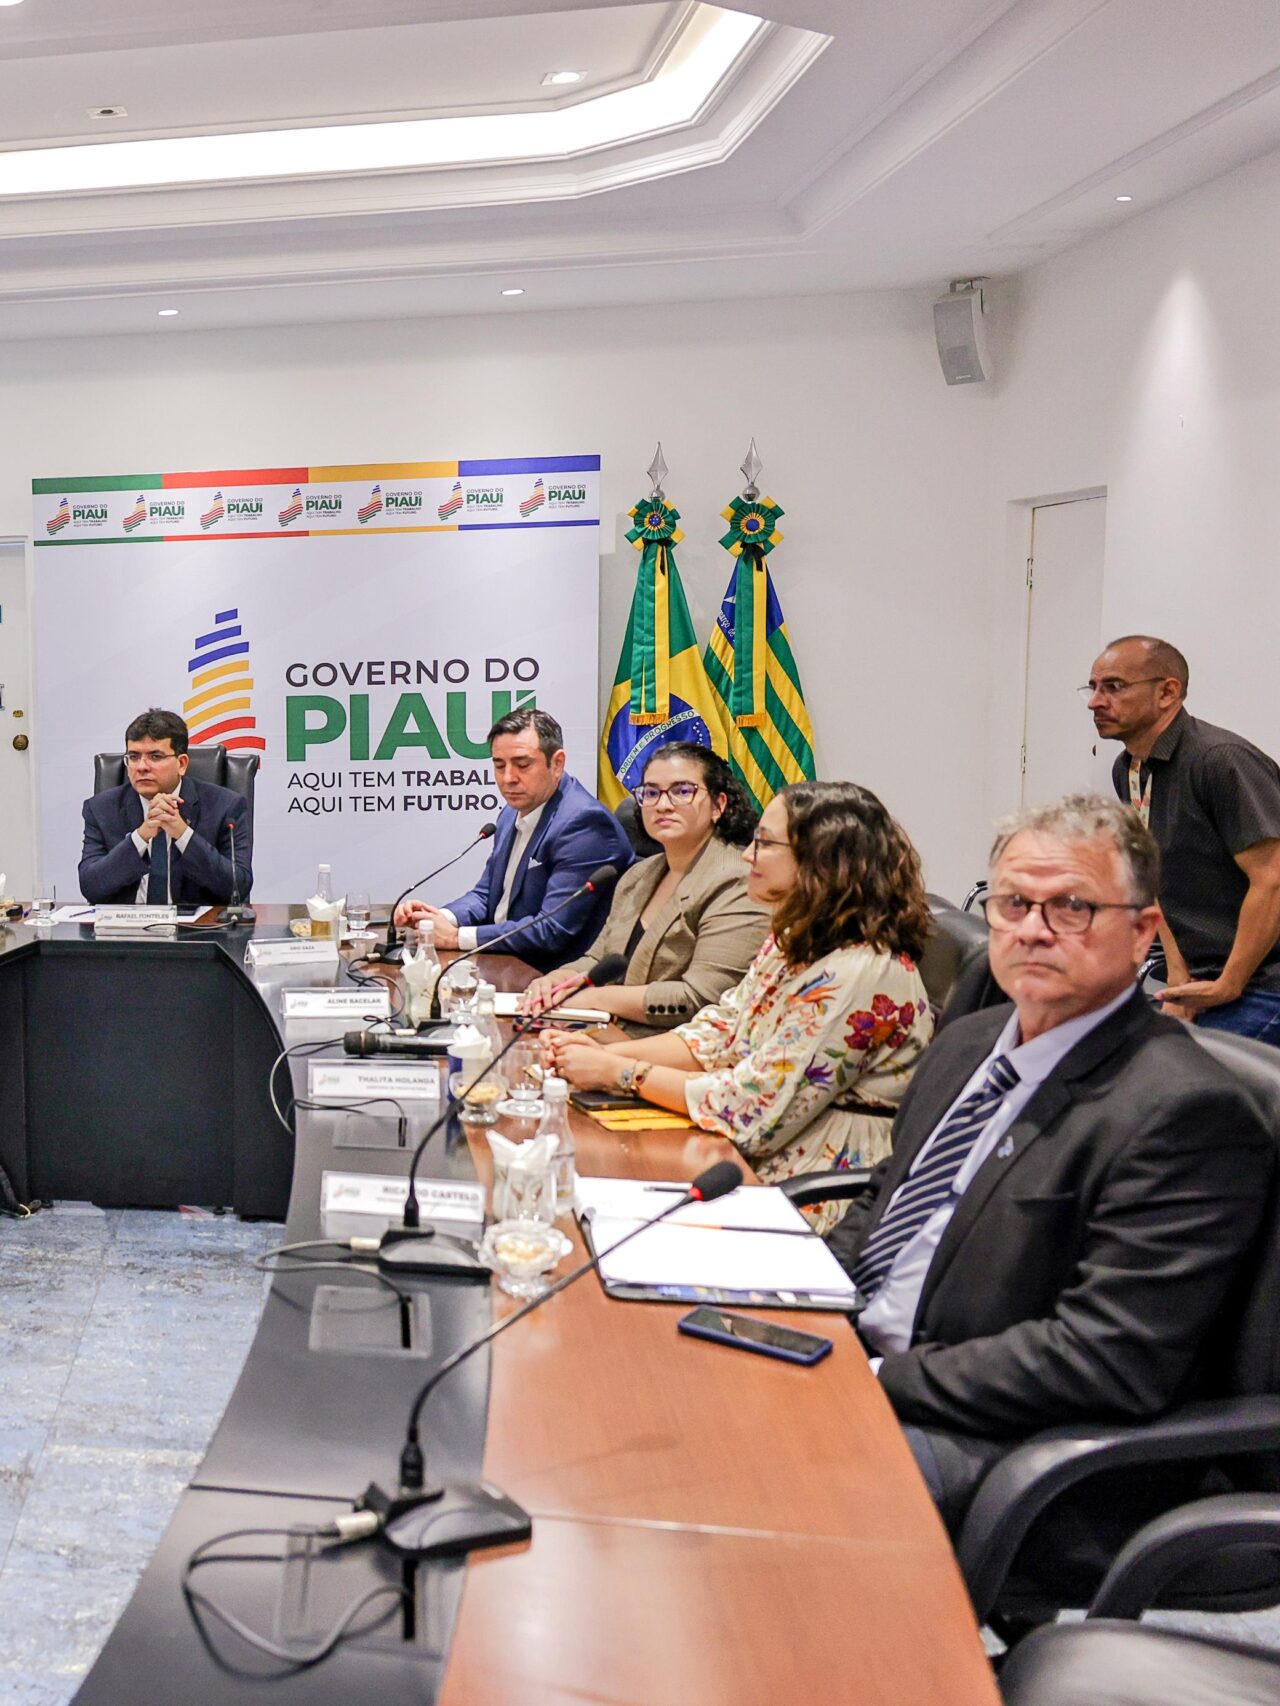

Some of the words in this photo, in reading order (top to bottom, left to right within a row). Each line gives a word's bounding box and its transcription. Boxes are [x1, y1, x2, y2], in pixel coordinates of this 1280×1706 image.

[286, 658, 469, 687] GOVERNO
[485, 657, 539, 682] DO
[286, 690, 536, 762] PIAU
[644, 711, 694, 742] PROGRESSO
[287, 772, 342, 791] AQUI
[349, 771, 395, 787] TEM
[402, 769, 496, 787] TRABAL
[287, 796, 342, 815] AQUI
[349, 795, 395, 812] TEM
[403, 794, 502, 812] FUTURO.
